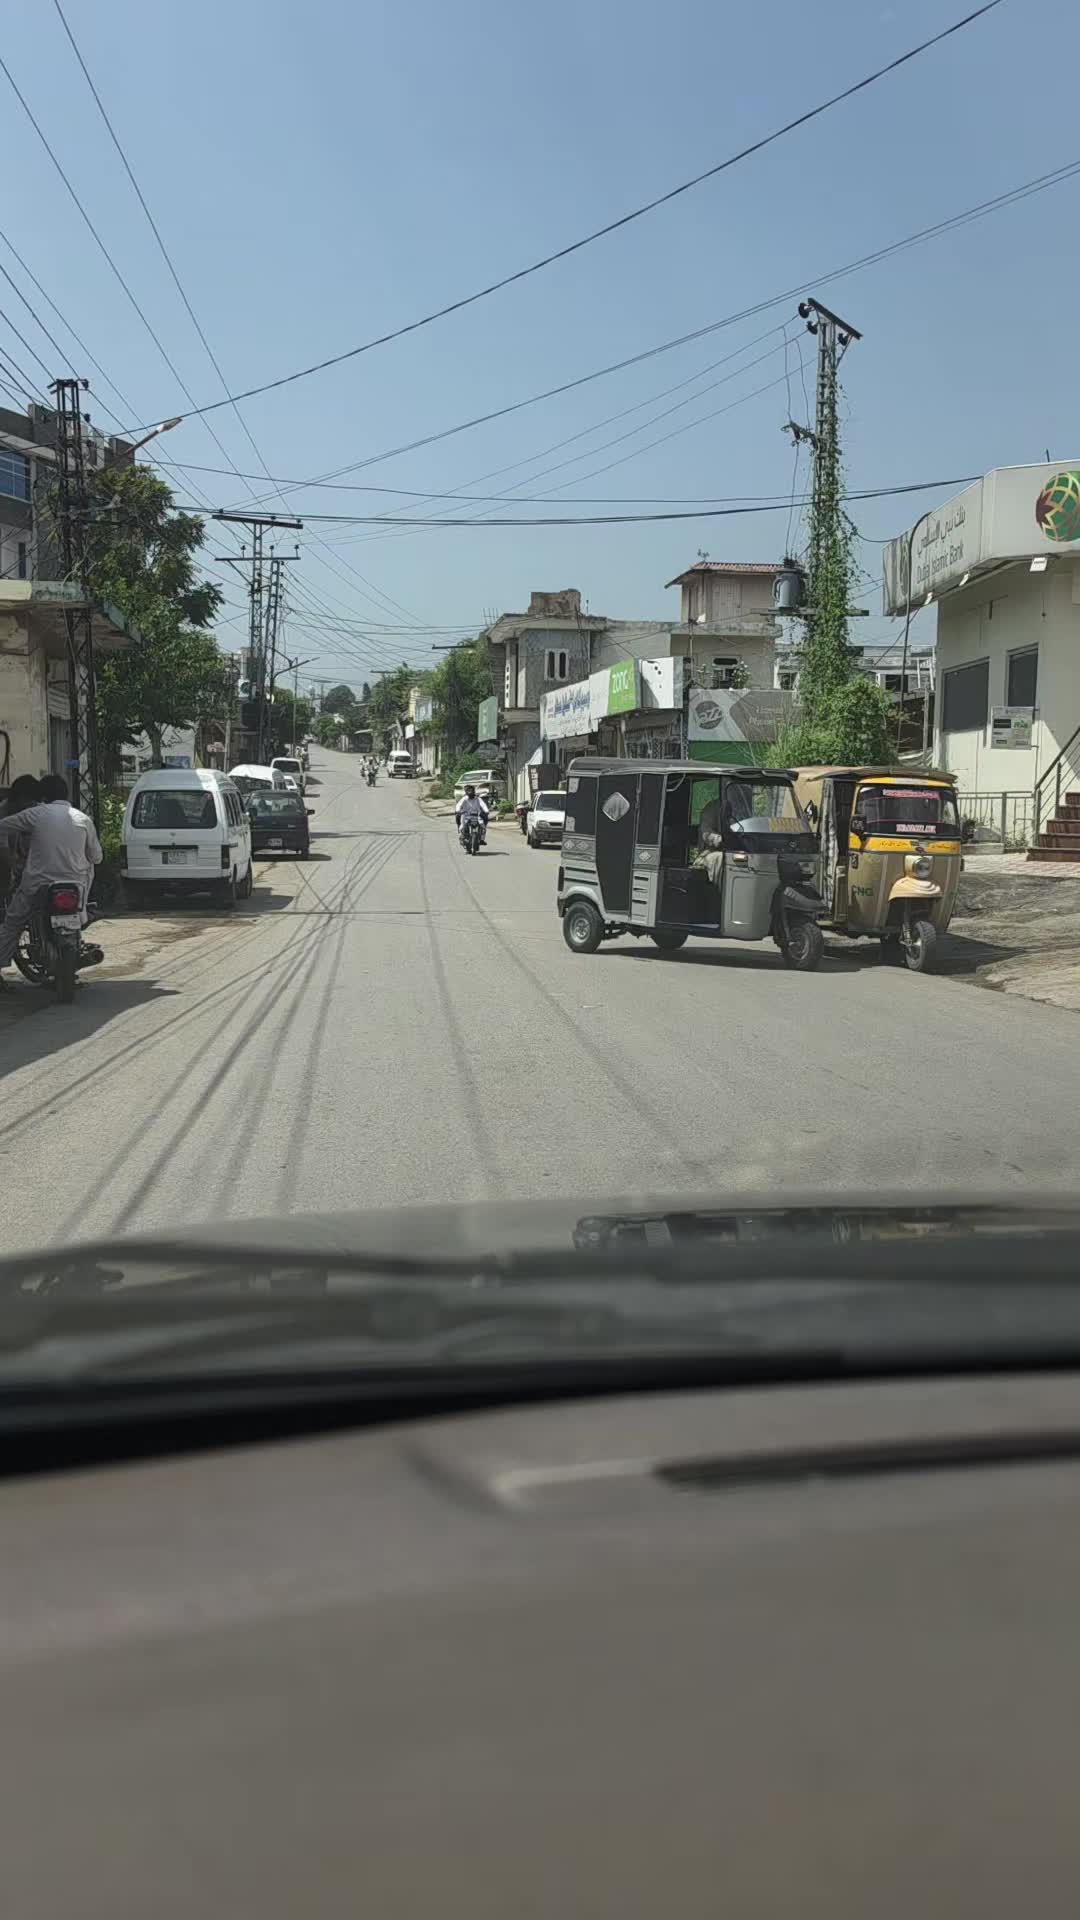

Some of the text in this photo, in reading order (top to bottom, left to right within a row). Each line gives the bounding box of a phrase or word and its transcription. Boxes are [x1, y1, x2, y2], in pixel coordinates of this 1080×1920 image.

[931, 551, 948, 576] Islamic
[949, 539, 964, 566] Bank
[851, 884, 874, 897] CNG
